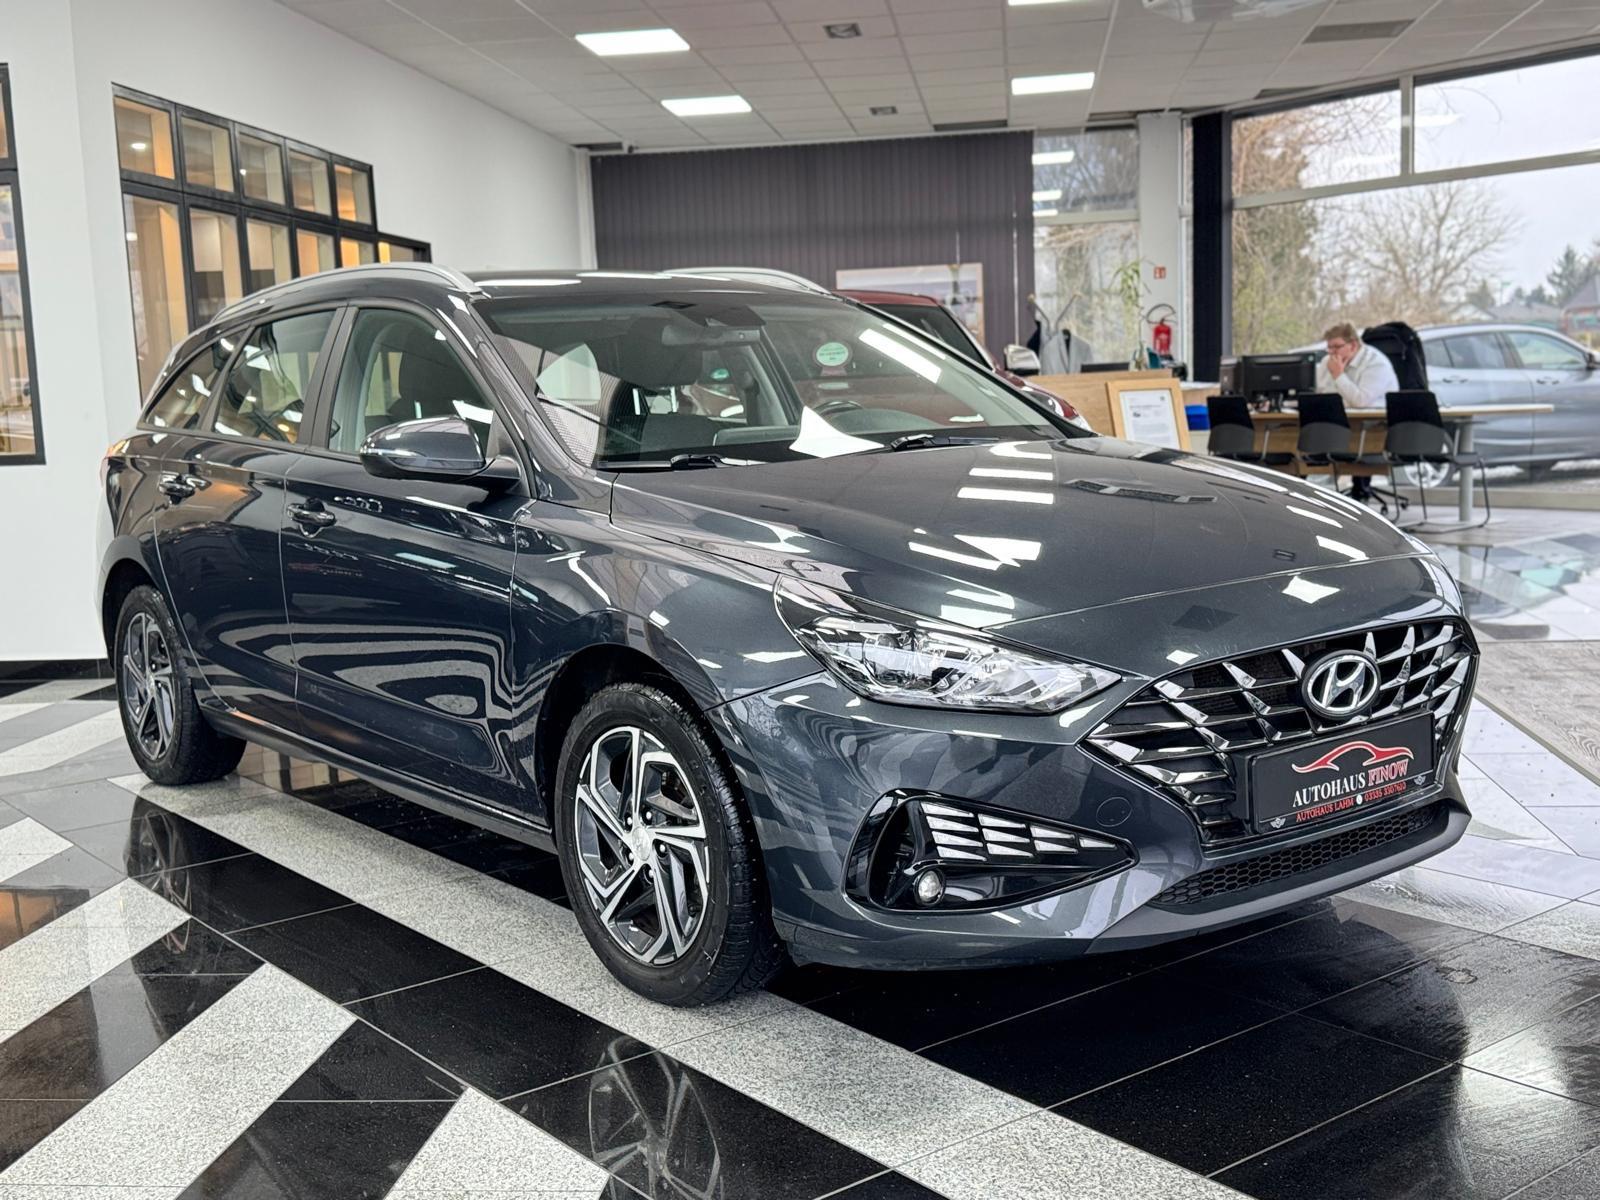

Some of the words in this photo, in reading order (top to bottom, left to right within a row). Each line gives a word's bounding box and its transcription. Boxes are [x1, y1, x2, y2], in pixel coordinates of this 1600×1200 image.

[1292, 772, 1366, 808] AUTOHAUS
[1367, 758, 1410, 787] FINOW
[1296, 804, 1334, 823] AUTOHAUS
[1334, 797, 1355, 811] LAHM
